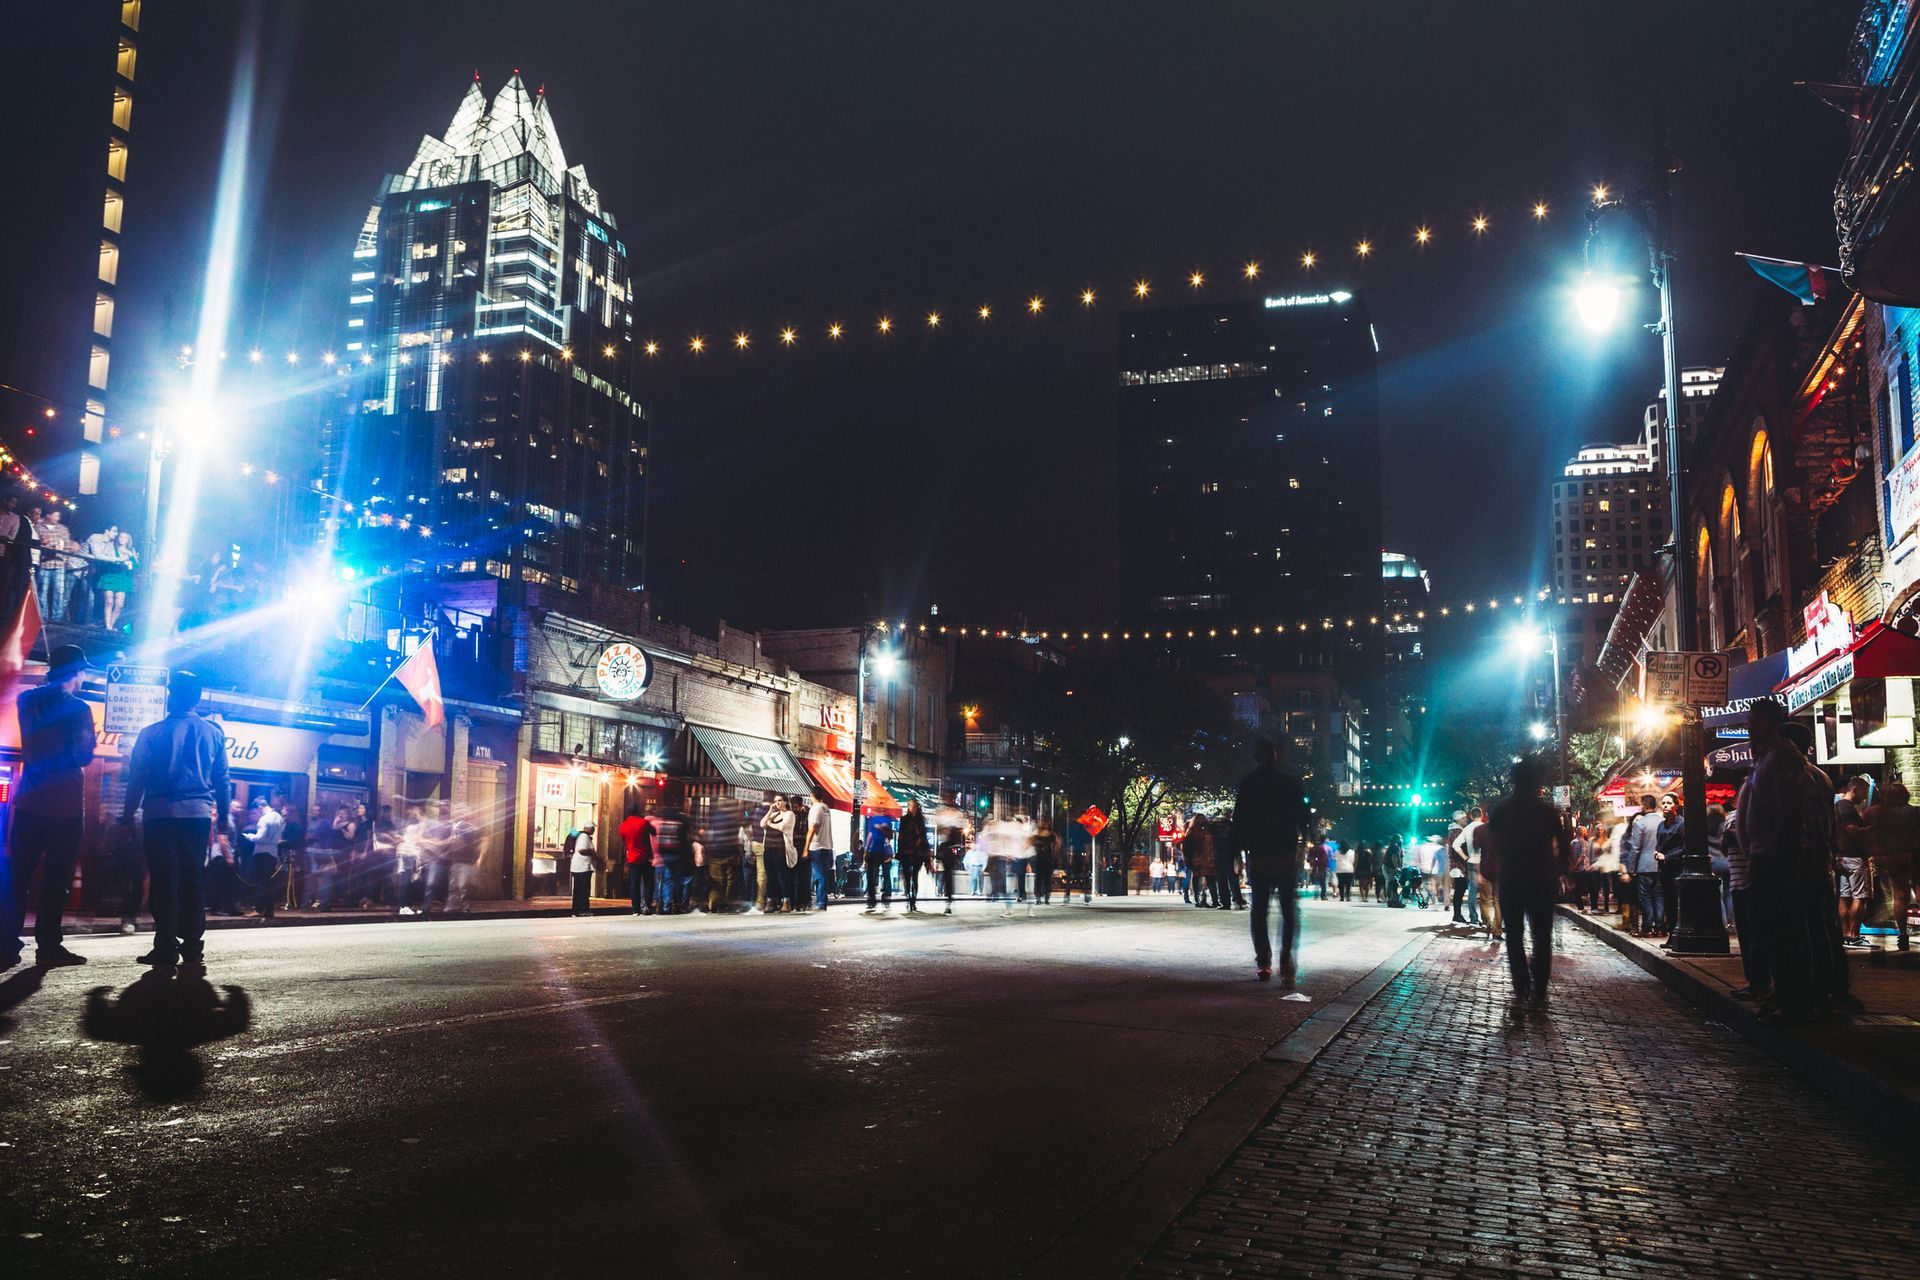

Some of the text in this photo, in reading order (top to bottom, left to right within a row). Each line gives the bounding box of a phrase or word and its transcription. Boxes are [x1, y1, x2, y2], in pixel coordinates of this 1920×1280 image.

[1265, 295, 1329, 308] Bank of America
[599, 645, 645, 678] PIZZARIA
[1648, 655, 1658, 670] 2
[1660, 663, 1683, 671] PARKING
[1661, 681, 1670, 689] TO
[108, 695, 164, 705] LOADING AND
[223, 737, 260, 760] Pub
[475, 745, 491, 758] ATM
[730, 752, 783, 774] 311
